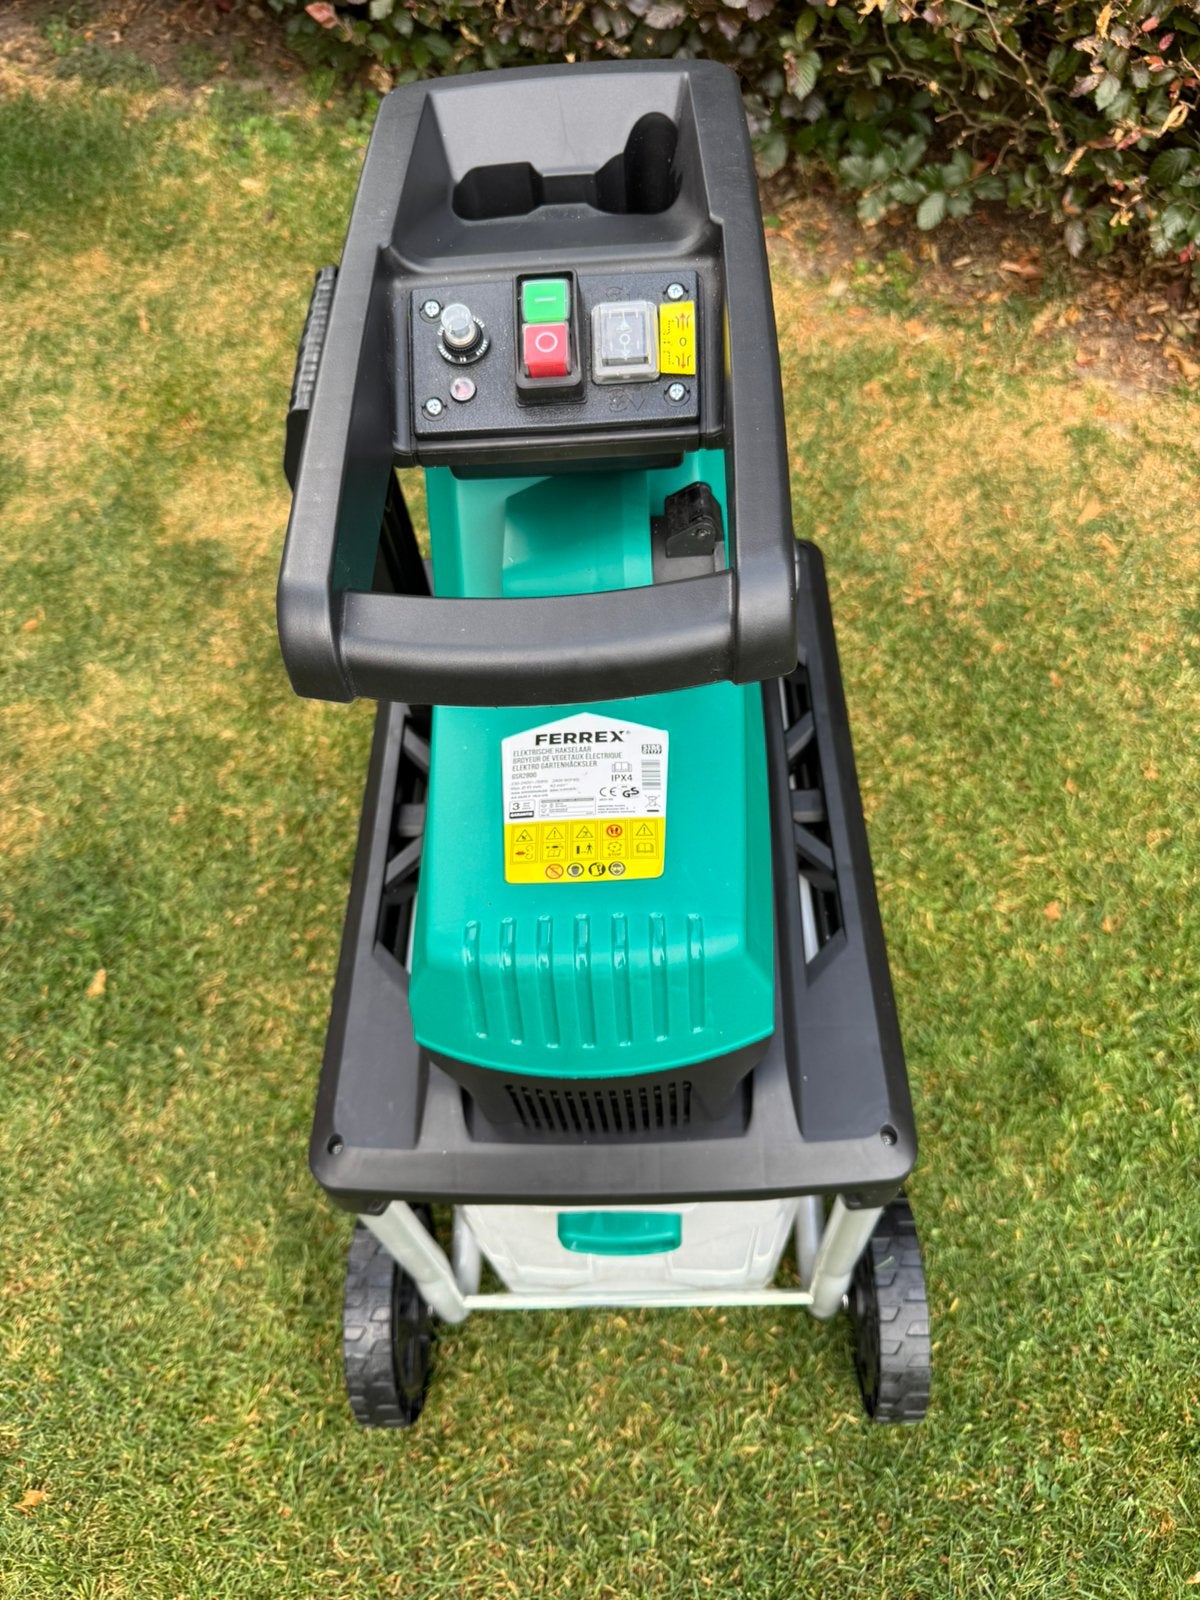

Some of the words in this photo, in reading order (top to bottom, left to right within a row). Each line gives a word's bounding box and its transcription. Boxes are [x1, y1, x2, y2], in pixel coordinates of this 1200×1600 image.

[535, 731, 624, 746] FERREX
[513, 747, 554, 757] ELEKTRISCHE
[554, 746, 592, 754] HAKSELAAR
[512, 755, 541, 764] BROYEUR
[542, 754, 550, 762] DE
[512, 762, 539, 772] ELEKTRO
[611, 774, 633, 782] IPX4
[512, 802, 520, 811] 3
